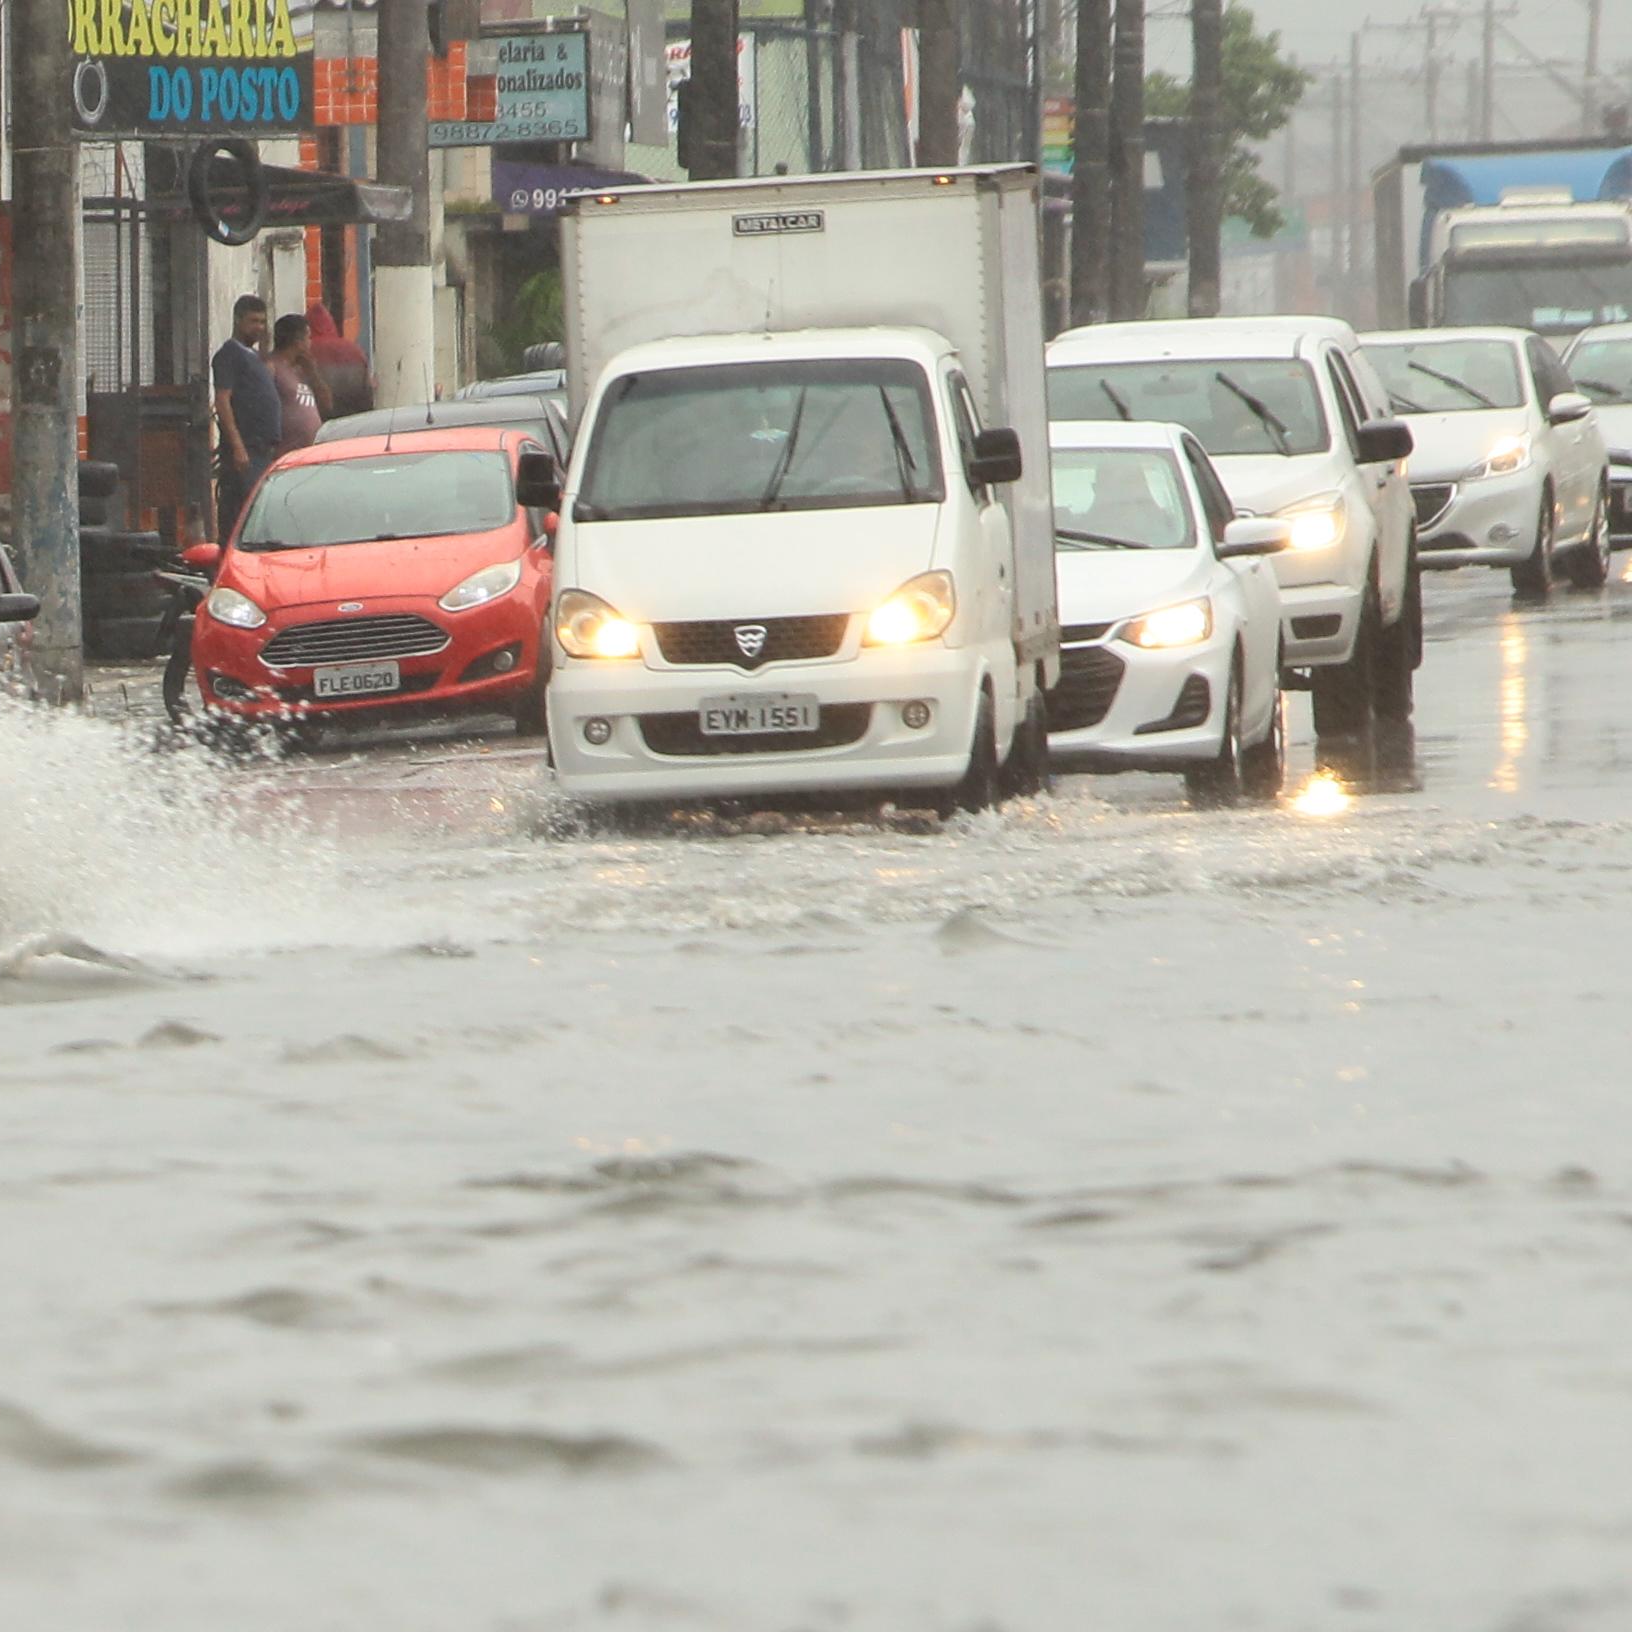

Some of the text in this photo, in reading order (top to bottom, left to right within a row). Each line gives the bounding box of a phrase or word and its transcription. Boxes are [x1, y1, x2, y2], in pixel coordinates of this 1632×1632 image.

[68, 0, 297, 57] RRACHARIA
[148, 65, 301, 122] DO POSTO
[434, 119, 579, 141] 98872-8365
[737, 215, 819, 231] METALCAR
